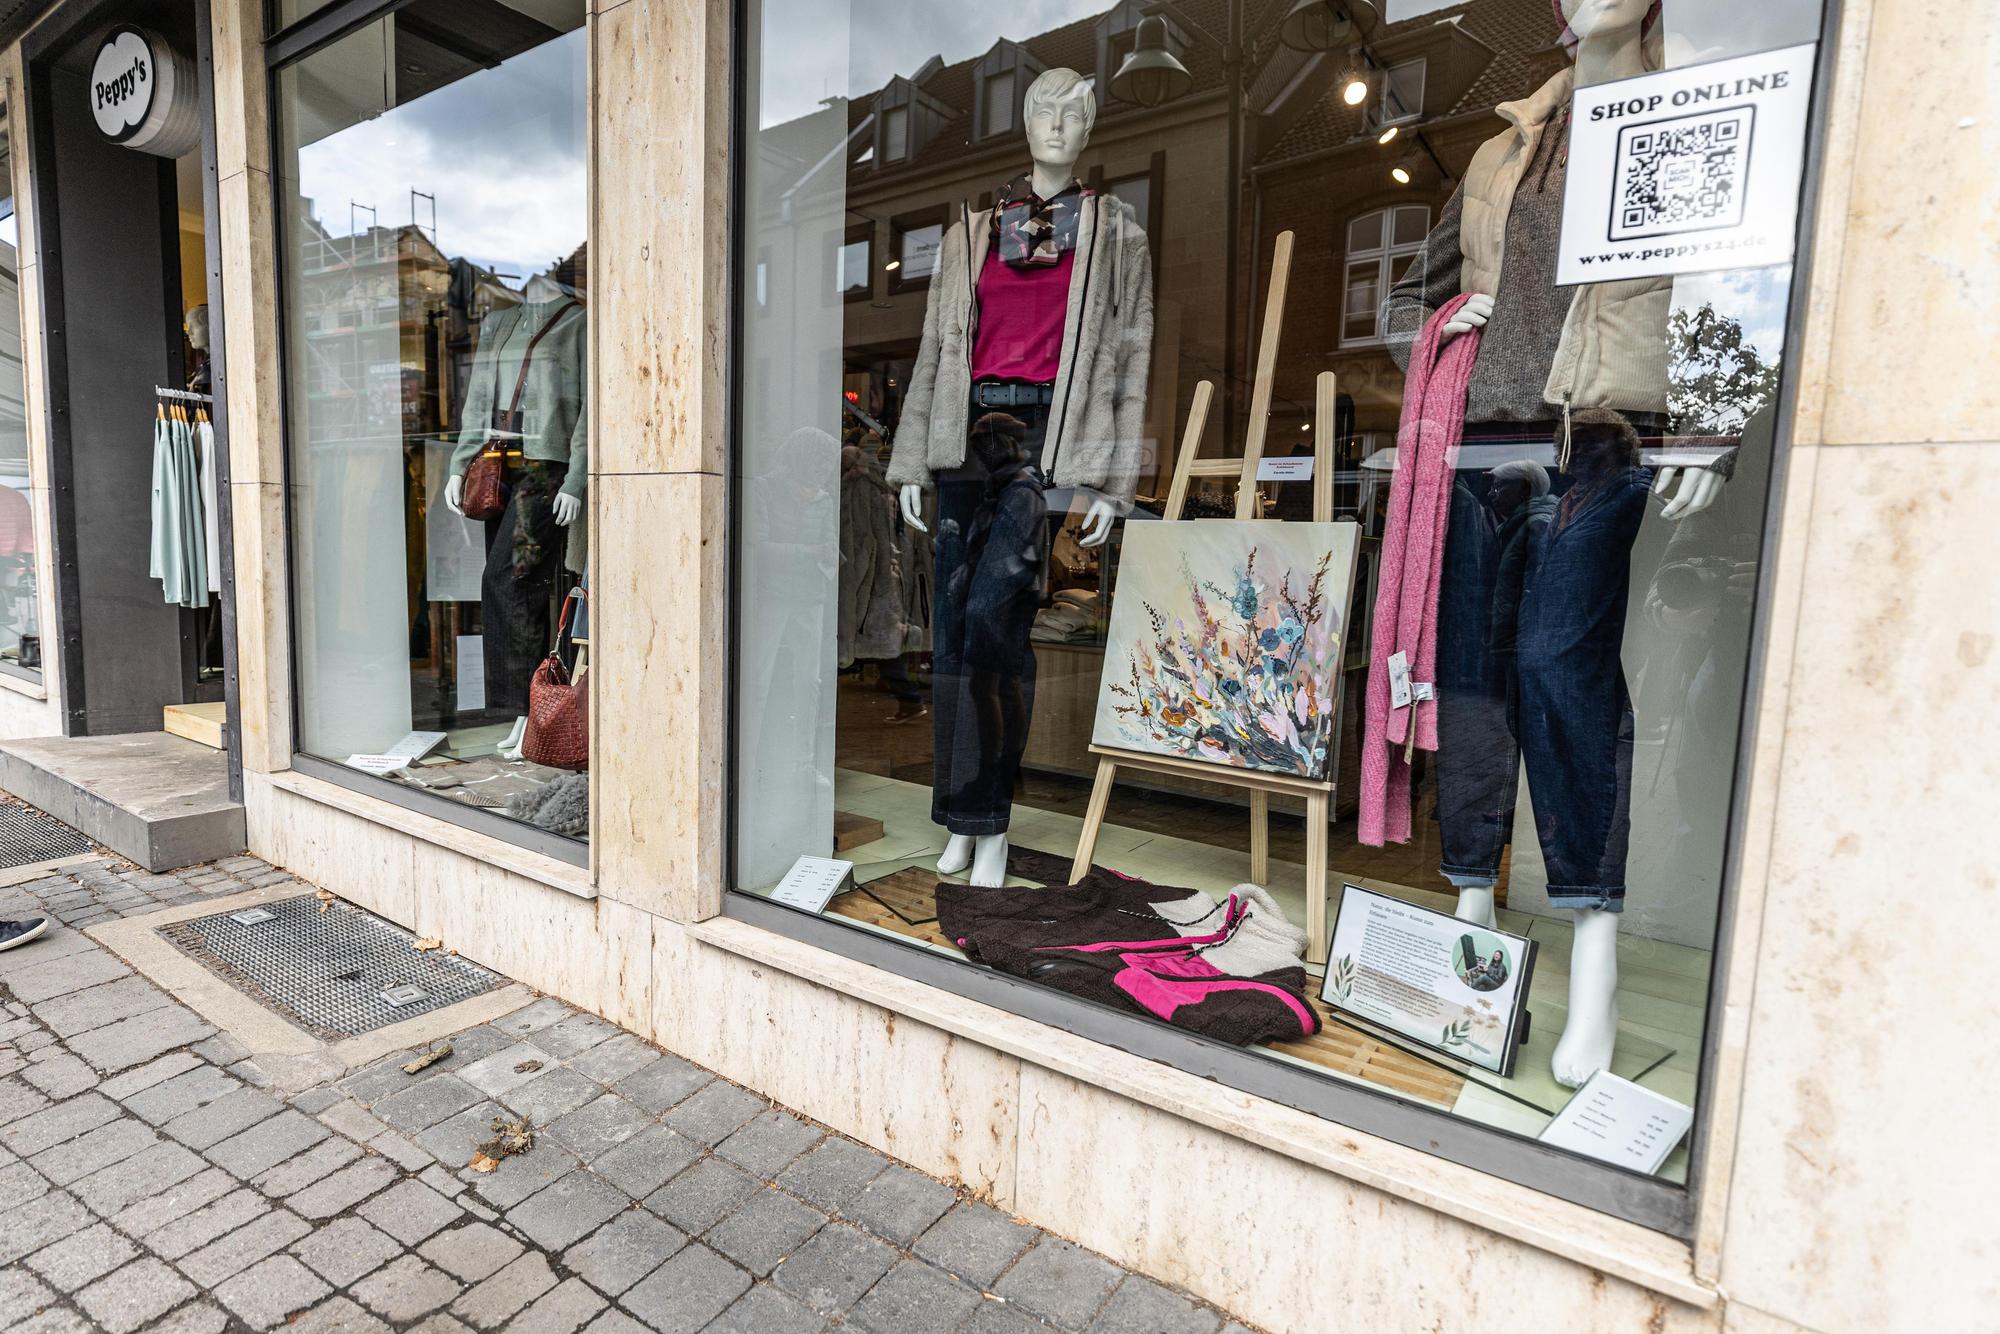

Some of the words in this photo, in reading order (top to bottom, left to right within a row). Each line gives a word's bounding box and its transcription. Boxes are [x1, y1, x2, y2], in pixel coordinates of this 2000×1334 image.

[95, 56, 147, 110] Peppy's
[1590, 95, 1663, 121] SHOP
[1672, 71, 1789, 106] ONLINE
